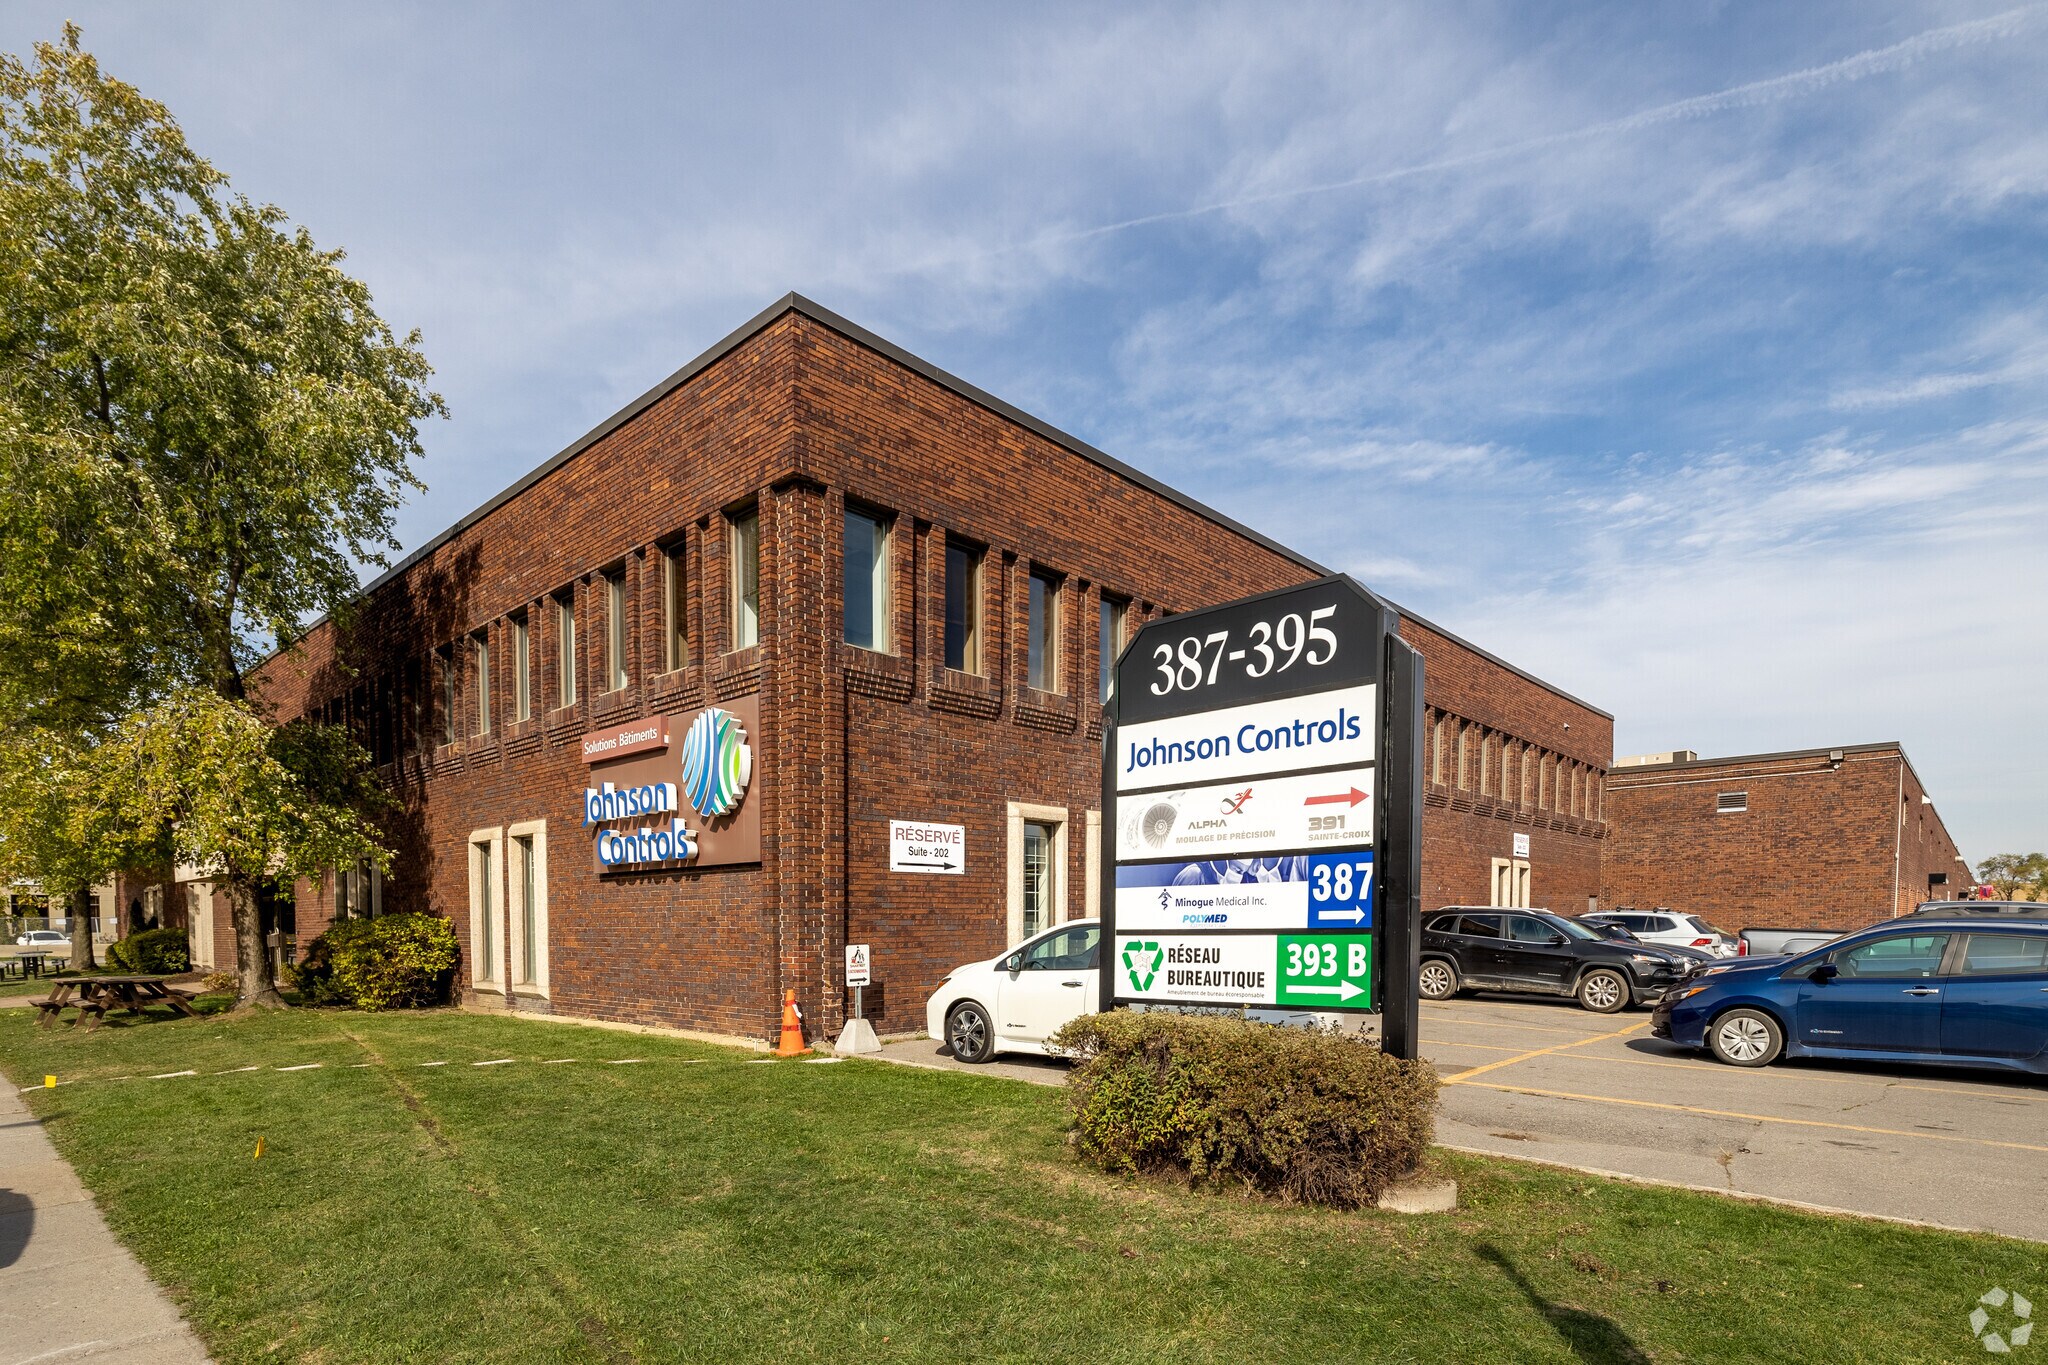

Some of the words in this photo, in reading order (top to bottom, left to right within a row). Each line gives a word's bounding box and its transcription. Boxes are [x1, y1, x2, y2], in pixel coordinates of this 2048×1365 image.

[1150, 603, 1338, 696] 387-395
[584, 737, 617, 755] Solutions
[619, 727, 658, 747] Bâtiments
[1126, 733, 1230, 773] Johnson
[1237, 708, 1361, 754] Controls
[582, 782, 670, 828] Johnson
[1188, 819, 1227, 830] ALPHA
[1308, 815, 1345, 831] 391
[598, 818, 690, 865] Controls
[895, 825, 961, 844] RÉSERVÉ
[1175, 834, 1214, 844] MOULAGE
[1217, 833, 1227, 841] DE
[1230, 829, 1276, 841] PRÉCISION
[1308, 830, 1371, 841] SAINTE-CROIX
[908, 845, 928, 857] Suite
[934, 847, 949, 858] 202
[1312, 862, 1374, 902] 387
[1175, 898, 1214, 909] Minogue
[1215, 896, 1250, 906] Medical
[1251, 896, 1268, 906] Inc.
[1182, 914, 1228, 924] POLYMED
[1167, 944, 1221, 964] RÉSEAU
[1286, 943, 1338, 977] 393
[1348, 943, 1367, 977] B
[1167, 970, 1265, 989] BUREAUTIQUE
[1225, 991, 1265, 999] écoresponsable
